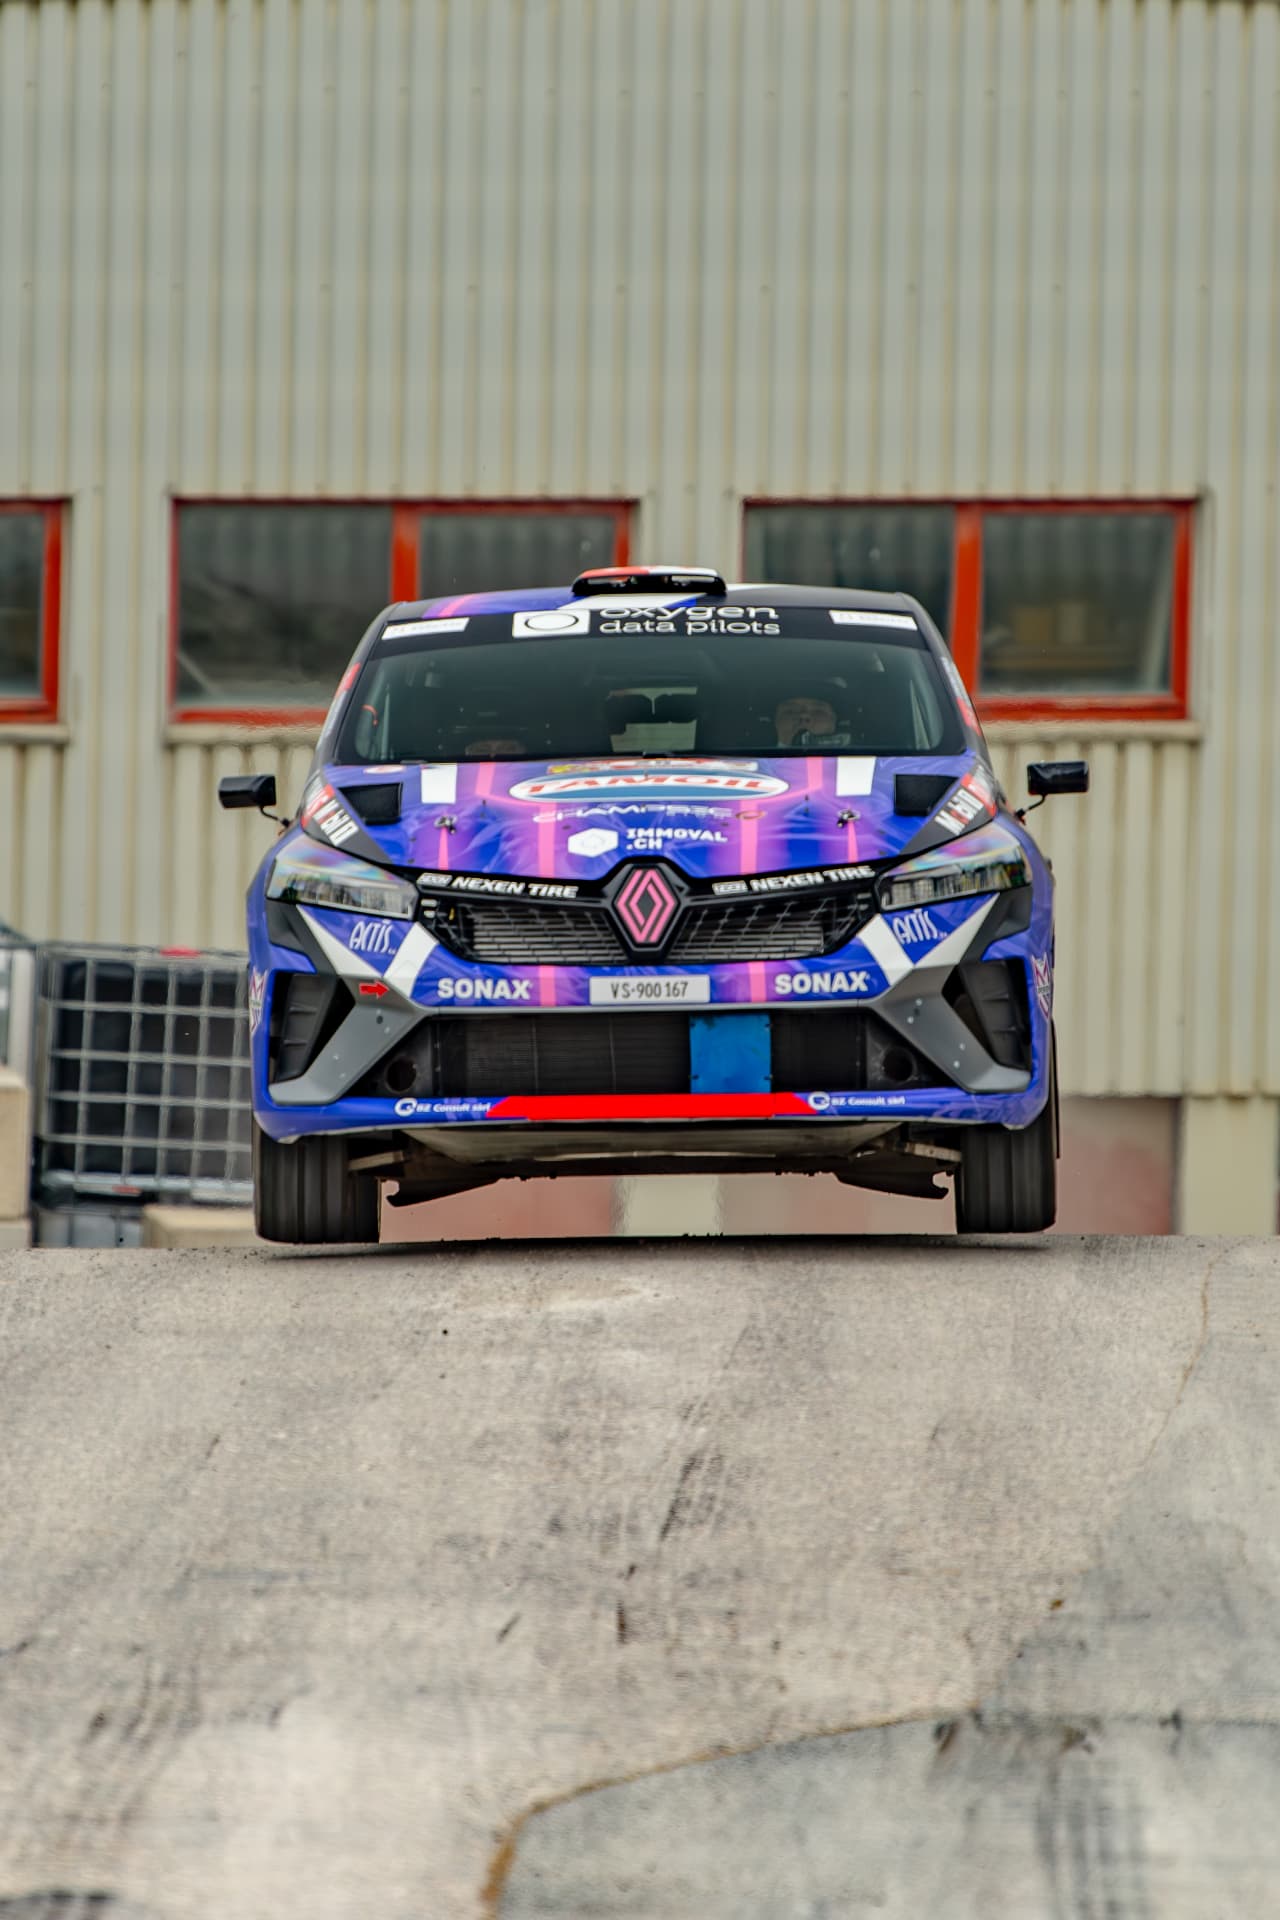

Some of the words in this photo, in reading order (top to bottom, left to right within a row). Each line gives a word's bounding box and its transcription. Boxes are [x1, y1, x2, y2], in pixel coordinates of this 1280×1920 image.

[600, 606, 779, 621] oxygen
[600, 620, 676, 634] data
[685, 619, 781, 635] pilots
[521, 775, 777, 793] TAMOIL
[626, 828, 728, 842] IMMOVAL
[626, 838, 663, 850] .CH
[749, 871, 824, 892] NEXEN
[823, 865, 876, 882] TIRE
[452, 876, 525, 895] NEXEN
[525, 883, 579, 899] TIRE
[437, 977, 530, 999] SONAX
[665, 981, 689, 998] 167
[775, 971, 869, 994] SONAX
